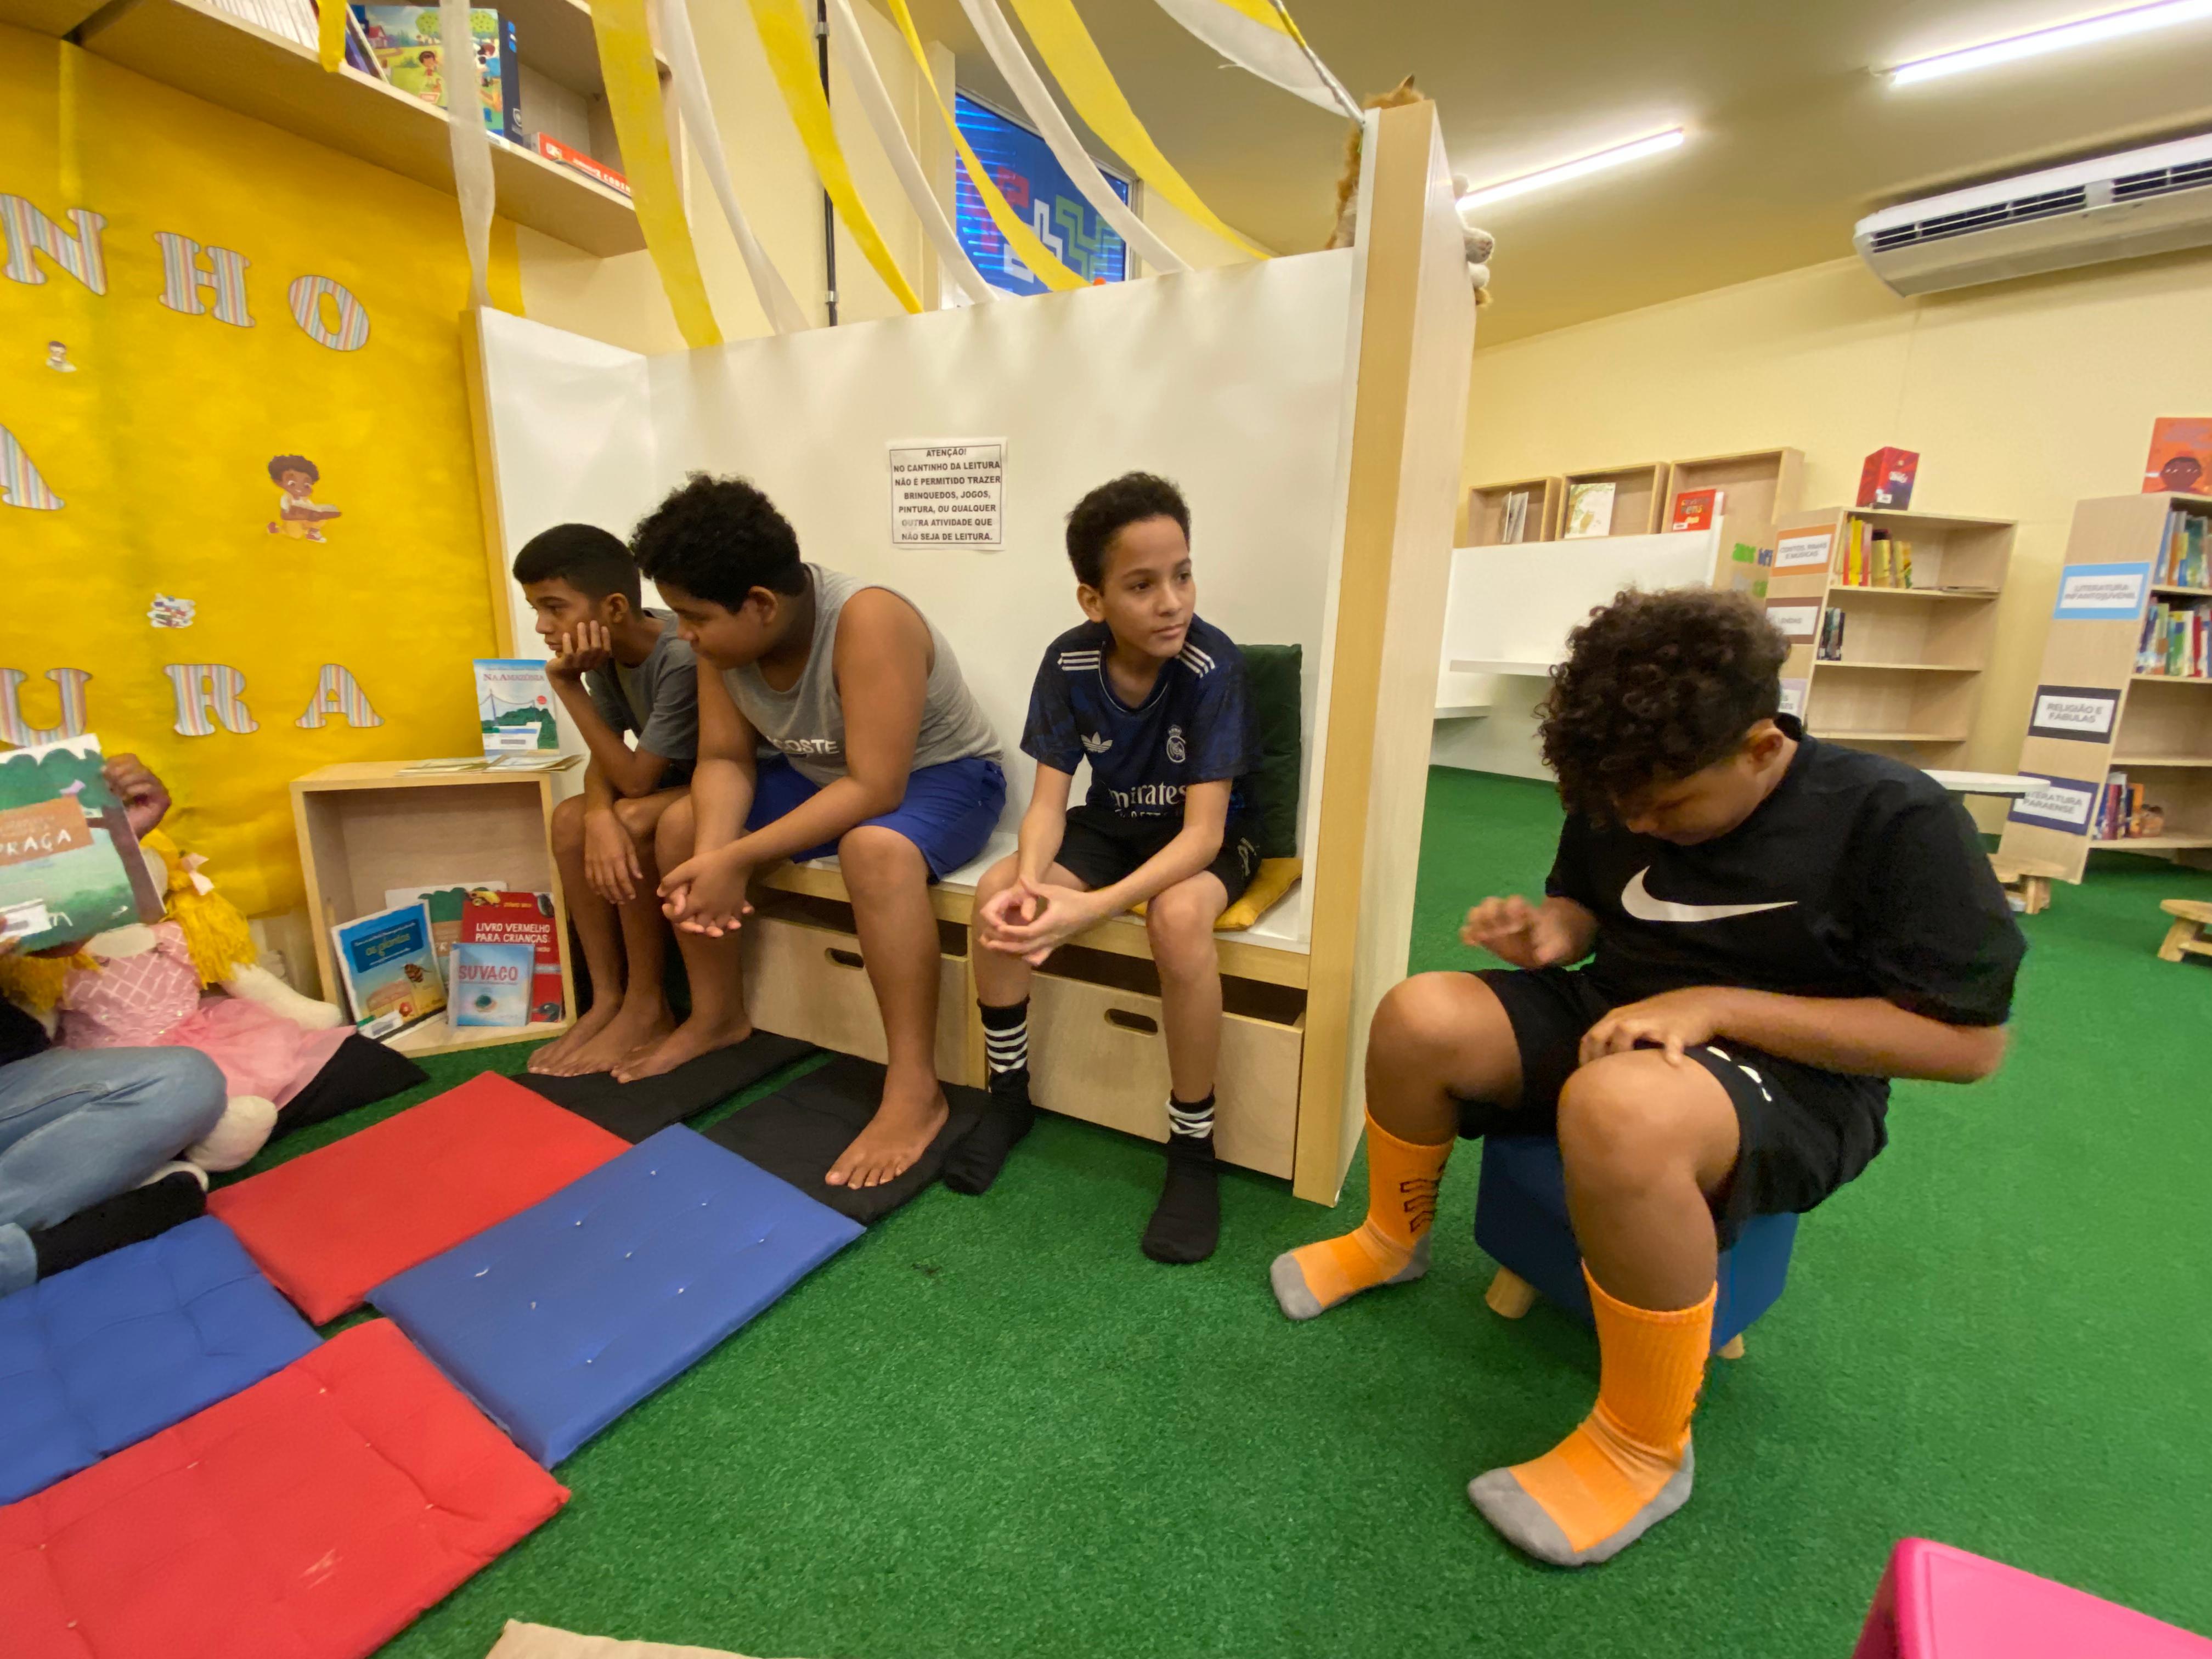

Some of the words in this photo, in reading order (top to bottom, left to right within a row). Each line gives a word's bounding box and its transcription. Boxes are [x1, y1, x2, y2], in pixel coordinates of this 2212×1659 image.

[926, 448, 967, 458] ATENÇÃO!
[907, 463, 948, 471] CANTINHO
[963, 461, 1001, 470] LEITURA
[895, 478, 911, 486] NÃO
[913, 477, 918, 486] É
[904, 492, 958, 500] BRINQUEDOS,
[960, 490, 991, 499] JOGOS,
[899, 505, 935, 514] PINTURA,
[1107, 781, 1187, 809] mirates
[476, 923, 503, 933] LIVRO
[505, 923, 551, 933] VERMELHO
[475, 933, 500, 943] PARA
[503, 934, 549, 943] CRIANÇAS
[459, 965, 519, 981] SUVACO
